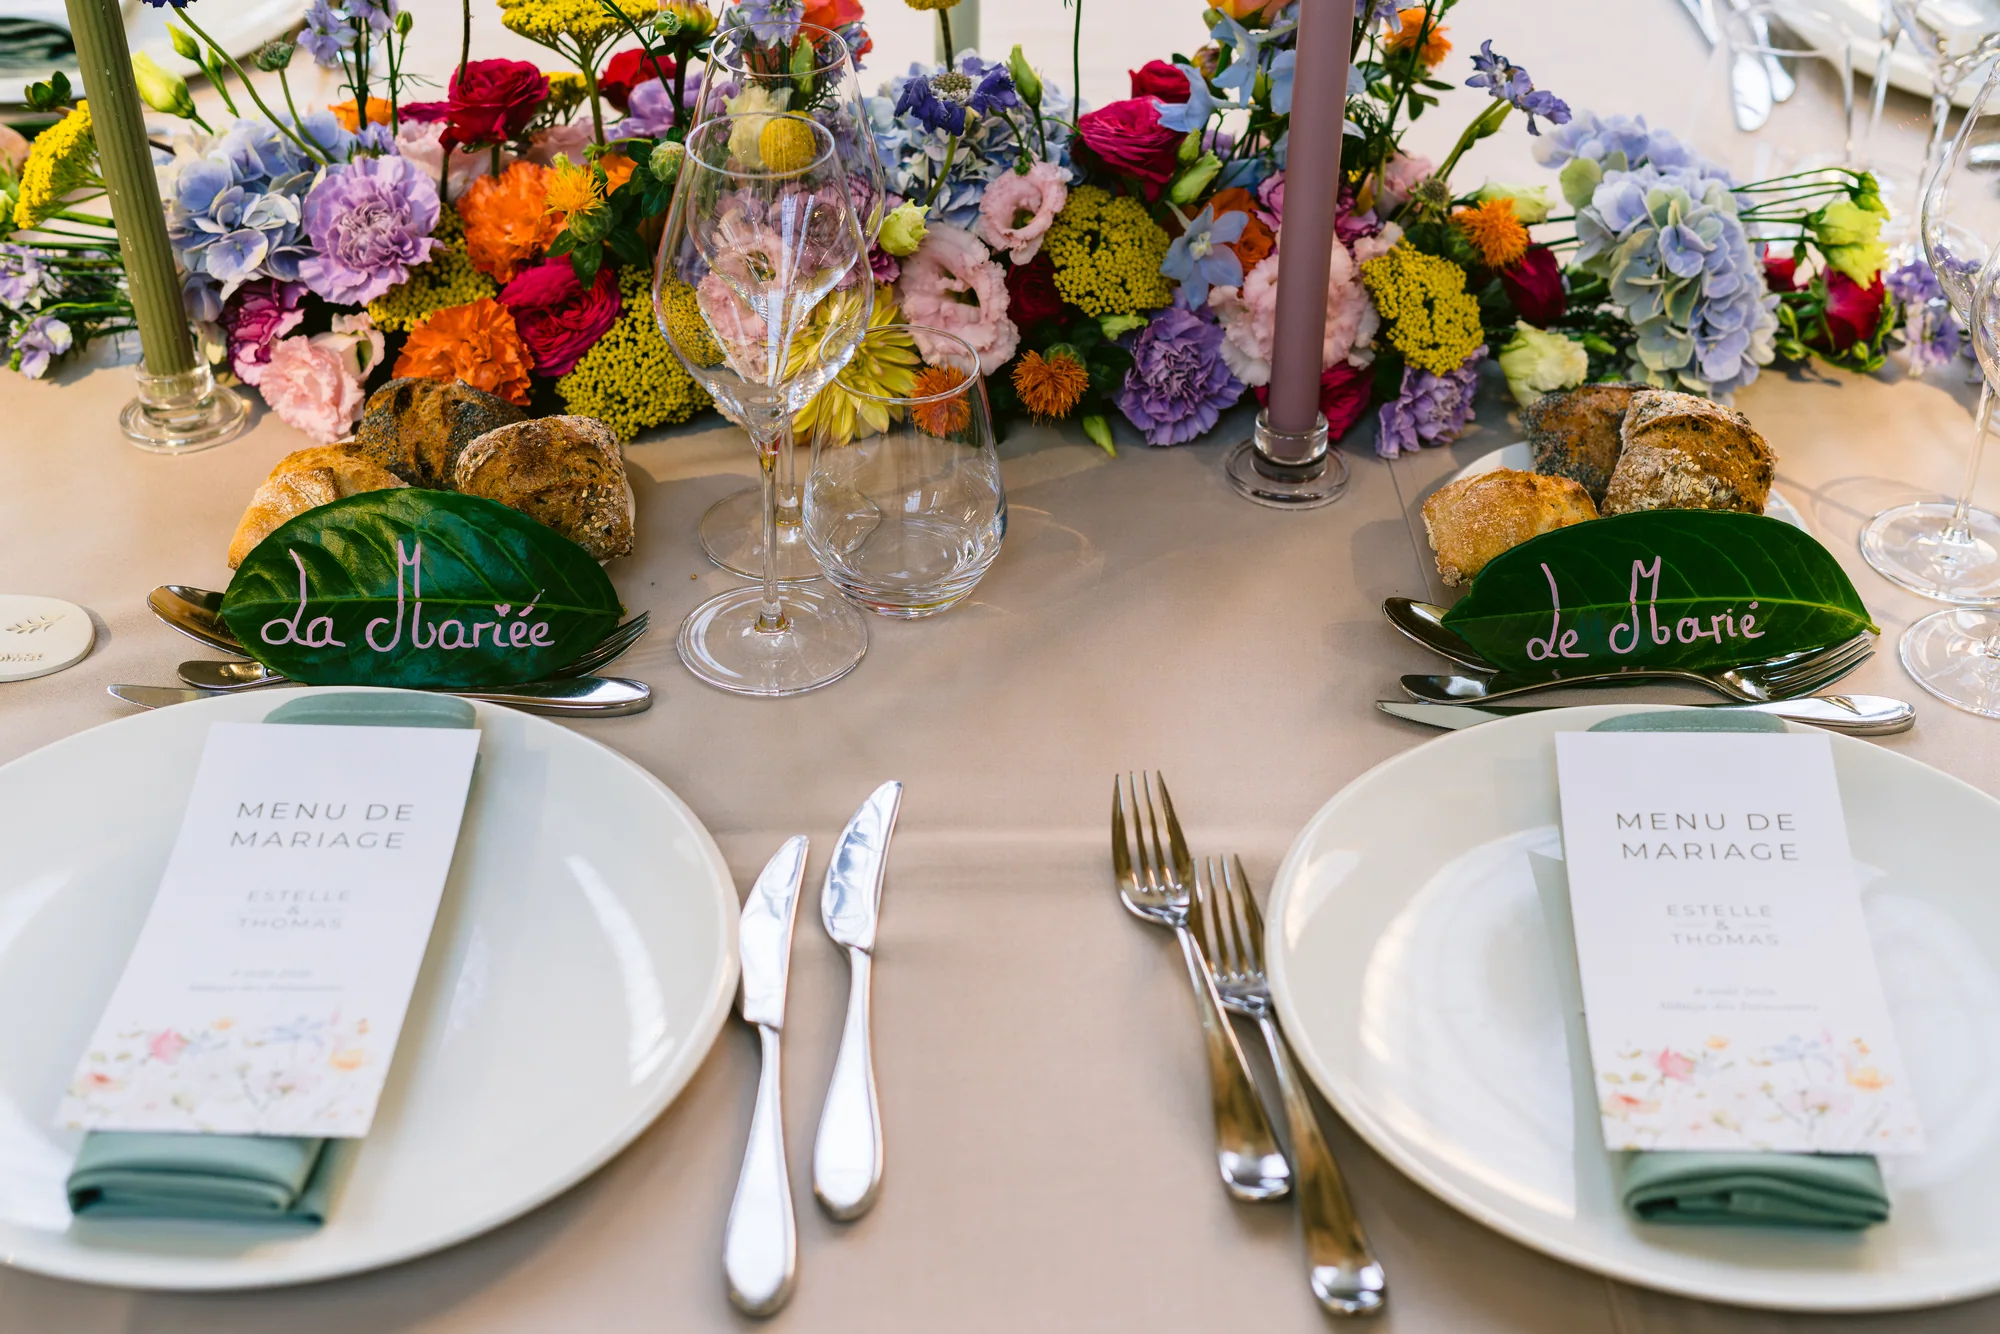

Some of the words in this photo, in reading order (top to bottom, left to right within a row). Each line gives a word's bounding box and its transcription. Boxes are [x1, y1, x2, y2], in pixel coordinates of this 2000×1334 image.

[260, 548, 347, 648] La
[365, 539, 556, 653] Mariée
[1526, 562, 1590, 661] Le
[1608, 555, 1766, 654] Marié
[237, 801, 348, 821] MENU
[364, 803, 415, 822] DE
[1616, 812, 1726, 831] MENU
[1746, 813, 1796, 832] DE
[229, 831, 406, 850] MARIAGE
[1622, 842, 1799, 861] MARIAGE
[247, 888, 353, 903] ESTELLE
[1666, 903, 1773, 918] ESTELLE
[237, 917, 343, 930] THOMAS
[1715, 919, 1730, 932] &
[1671, 932, 1780, 947] THOMAS
